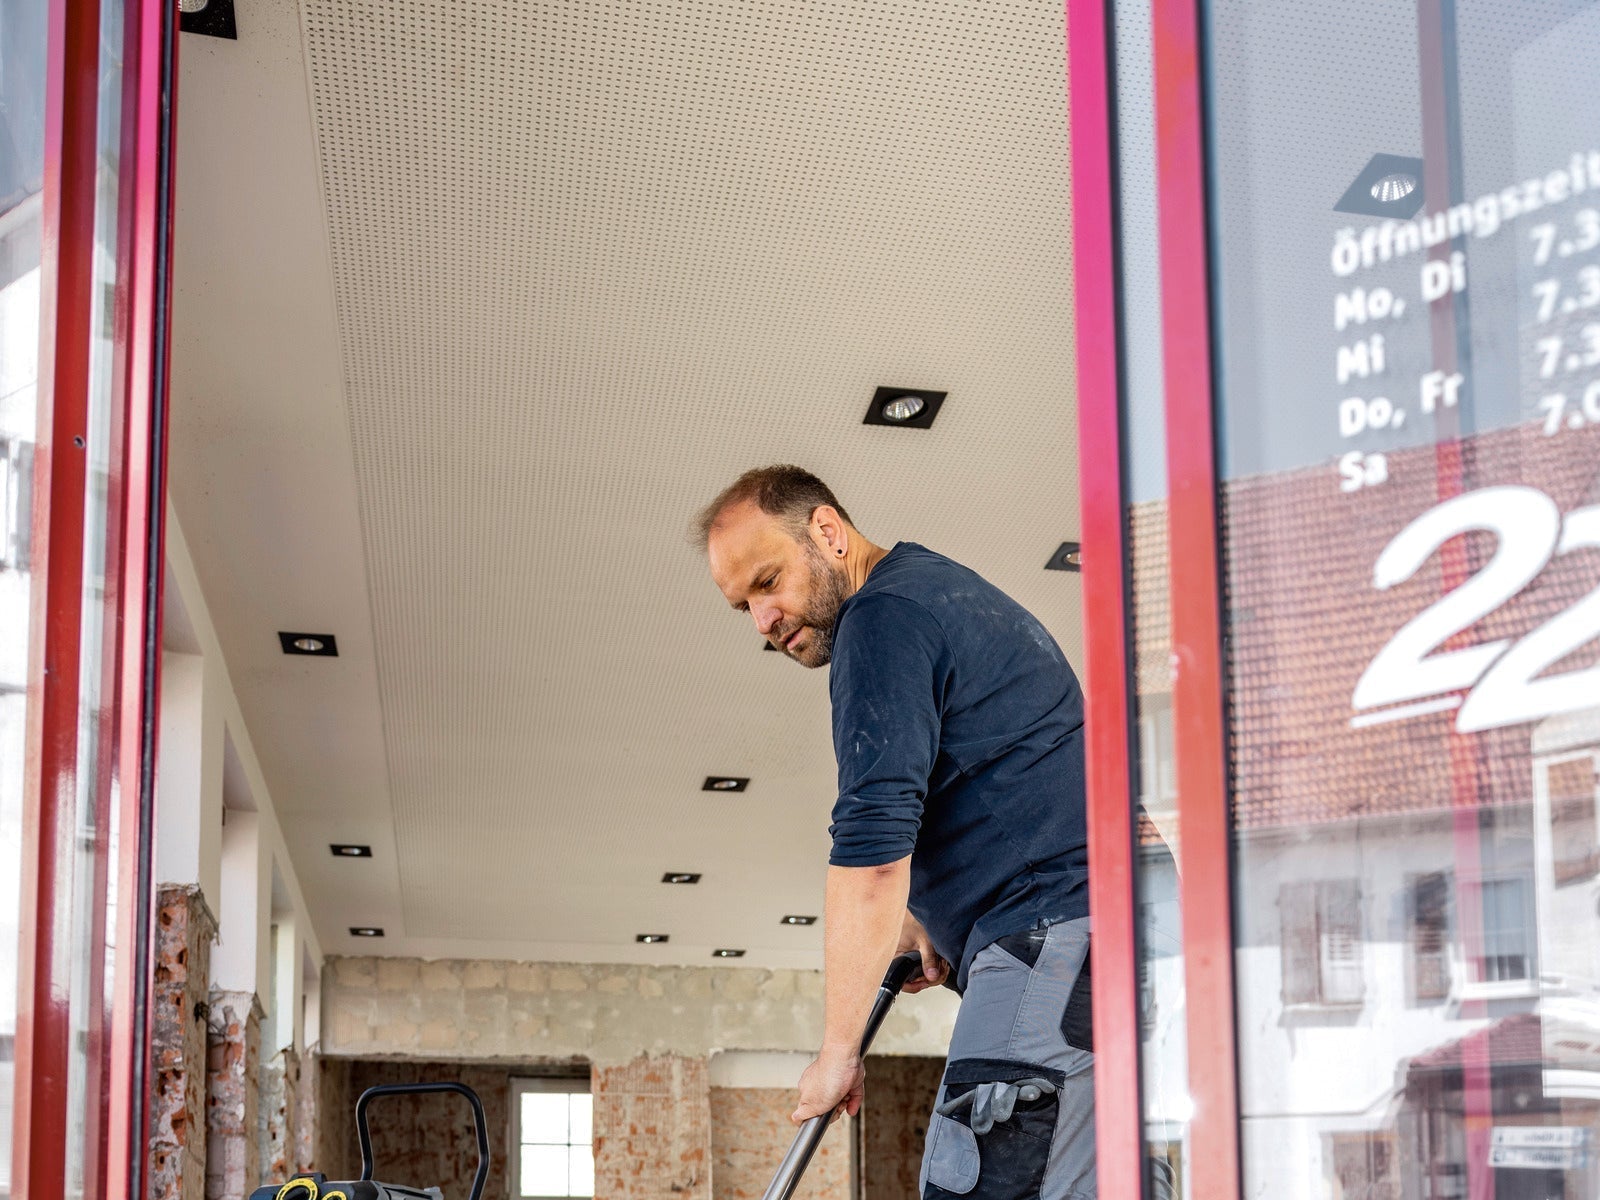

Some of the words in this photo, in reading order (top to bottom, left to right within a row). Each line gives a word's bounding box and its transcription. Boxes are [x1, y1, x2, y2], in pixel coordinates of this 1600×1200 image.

[1331, 151, 1600, 277] Öffnungszeit
[1335, 286, 1405, 331] Mo,
[1420, 251, 1466, 301] Di
[1336, 333, 1385, 384] Mi
[1339, 397, 1406, 437] Do,
[1420, 370, 1464, 413] Fr
[1339, 450, 1389, 493] Sa
